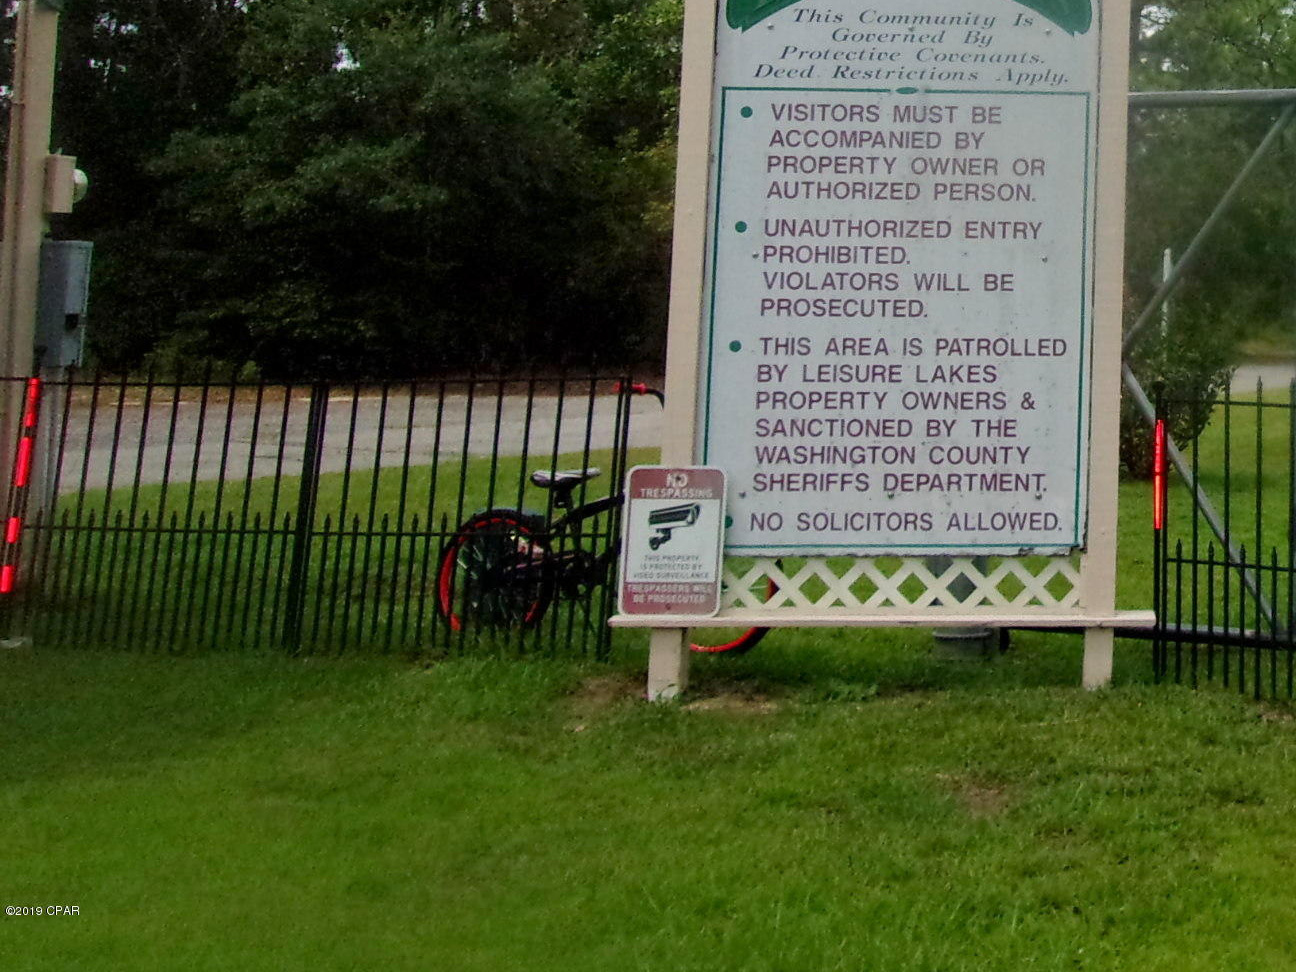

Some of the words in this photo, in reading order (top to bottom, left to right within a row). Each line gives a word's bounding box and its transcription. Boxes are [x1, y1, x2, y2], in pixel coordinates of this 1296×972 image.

[793, 7, 844, 24] This
[858, 8, 1000, 29] Community
[1012, 12, 1034, 27] Is
[831, 26, 945, 44] Governed
[963, 29, 993, 48] By
[778, 45, 902, 62] Protective
[916, 47, 1045, 64] Covenants.
[753, 63, 815, 80] Deed
[831, 64, 979, 82] Restrictions
[995, 68, 1070, 86] Apply.
[771, 103, 880, 123] VISITORS
[893, 105, 958, 124] MUST
[971, 106, 1003, 125] BE
[768, 129, 943, 149] ACCOMPANIED
[955, 132, 986, 150] BY
[766, 156, 897, 175] PROPERTY
[911, 157, 999, 176] OWNER
[1012, 158, 1046, 177] OR
[766, 181, 921, 201] AUTHORIZED
[933, 182, 1037, 202] PERSON.
[764, 219, 952, 239] UNAUTHORIZED
[965, 220, 1043, 240] ENTRY
[763, 245, 911, 265] PROHIBITED.
[763, 272, 899, 292] VIOLATORS
[913, 273, 970, 292] WILL
[983, 273, 1015, 292] BE
[760, 298, 928, 318] PROSECUTED.
[760, 337, 811, 356] THIS
[824, 337, 890, 357] AREA
[902, 338, 923, 357] IS
[936, 338, 1068, 357] PATROLLED
[757, 364, 788, 383] BY
[802, 364, 902, 383] LEISURE
[915, 364, 998, 384] LAKES
[755, 391, 888, 411] PROPERTY
[902, 391, 1007, 411] OWNERS
[1021, 392, 1036, 411] &
[754, 418, 914, 438] SANCTIONED
[926, 419, 957, 438] BY
[971, 419, 1018, 438] THE
[755, 445, 916, 465] WASHINGTON
[928, 445, 1031, 465] COUNTY
[666, 473, 689, 488] NO
[752, 473, 870, 492] SHERIFFS
[883, 473, 1048, 493] DEPARTMENT.
[640, 488, 714, 499] TRESPASSING
[750, 512, 784, 532] NO
[796, 512, 933, 532] SOLICITORS
[946, 512, 1063, 532] ALLOWED.
